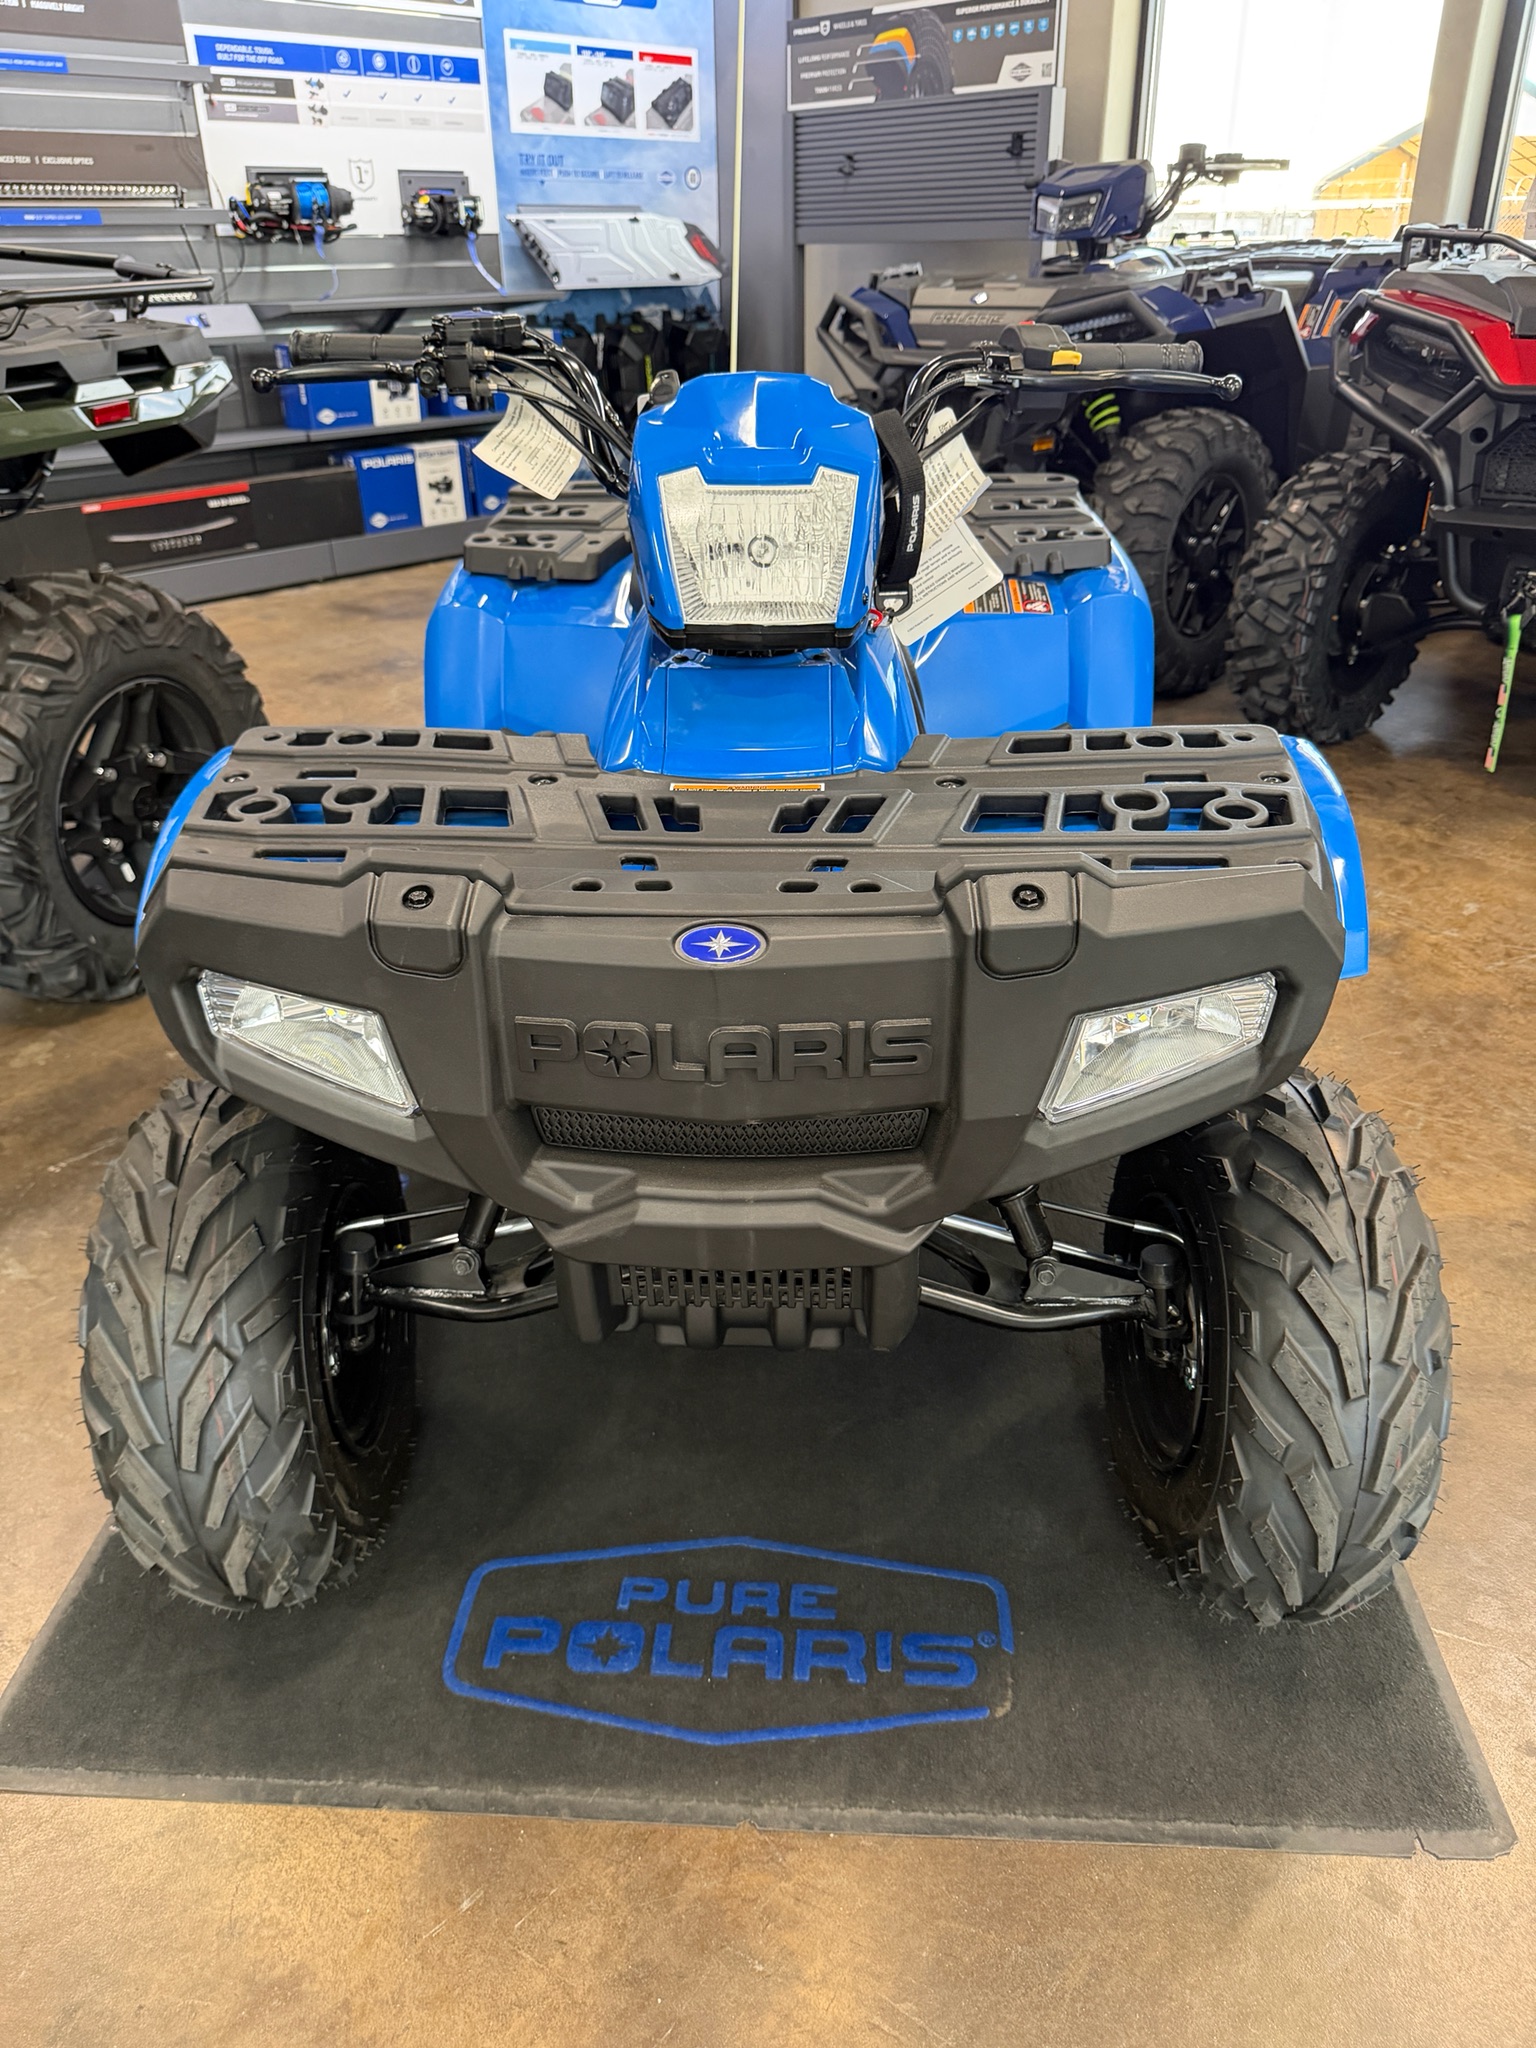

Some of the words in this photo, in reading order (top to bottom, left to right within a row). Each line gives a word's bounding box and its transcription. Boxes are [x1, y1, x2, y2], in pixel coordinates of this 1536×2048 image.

[929, 312, 1006, 325] POLARIS
[361, 453, 415, 470] POLARIS
[906, 494, 920, 552] POLARIS
[514, 1016, 933, 1081] POLARIS
[617, 1576, 838, 1620] PURE
